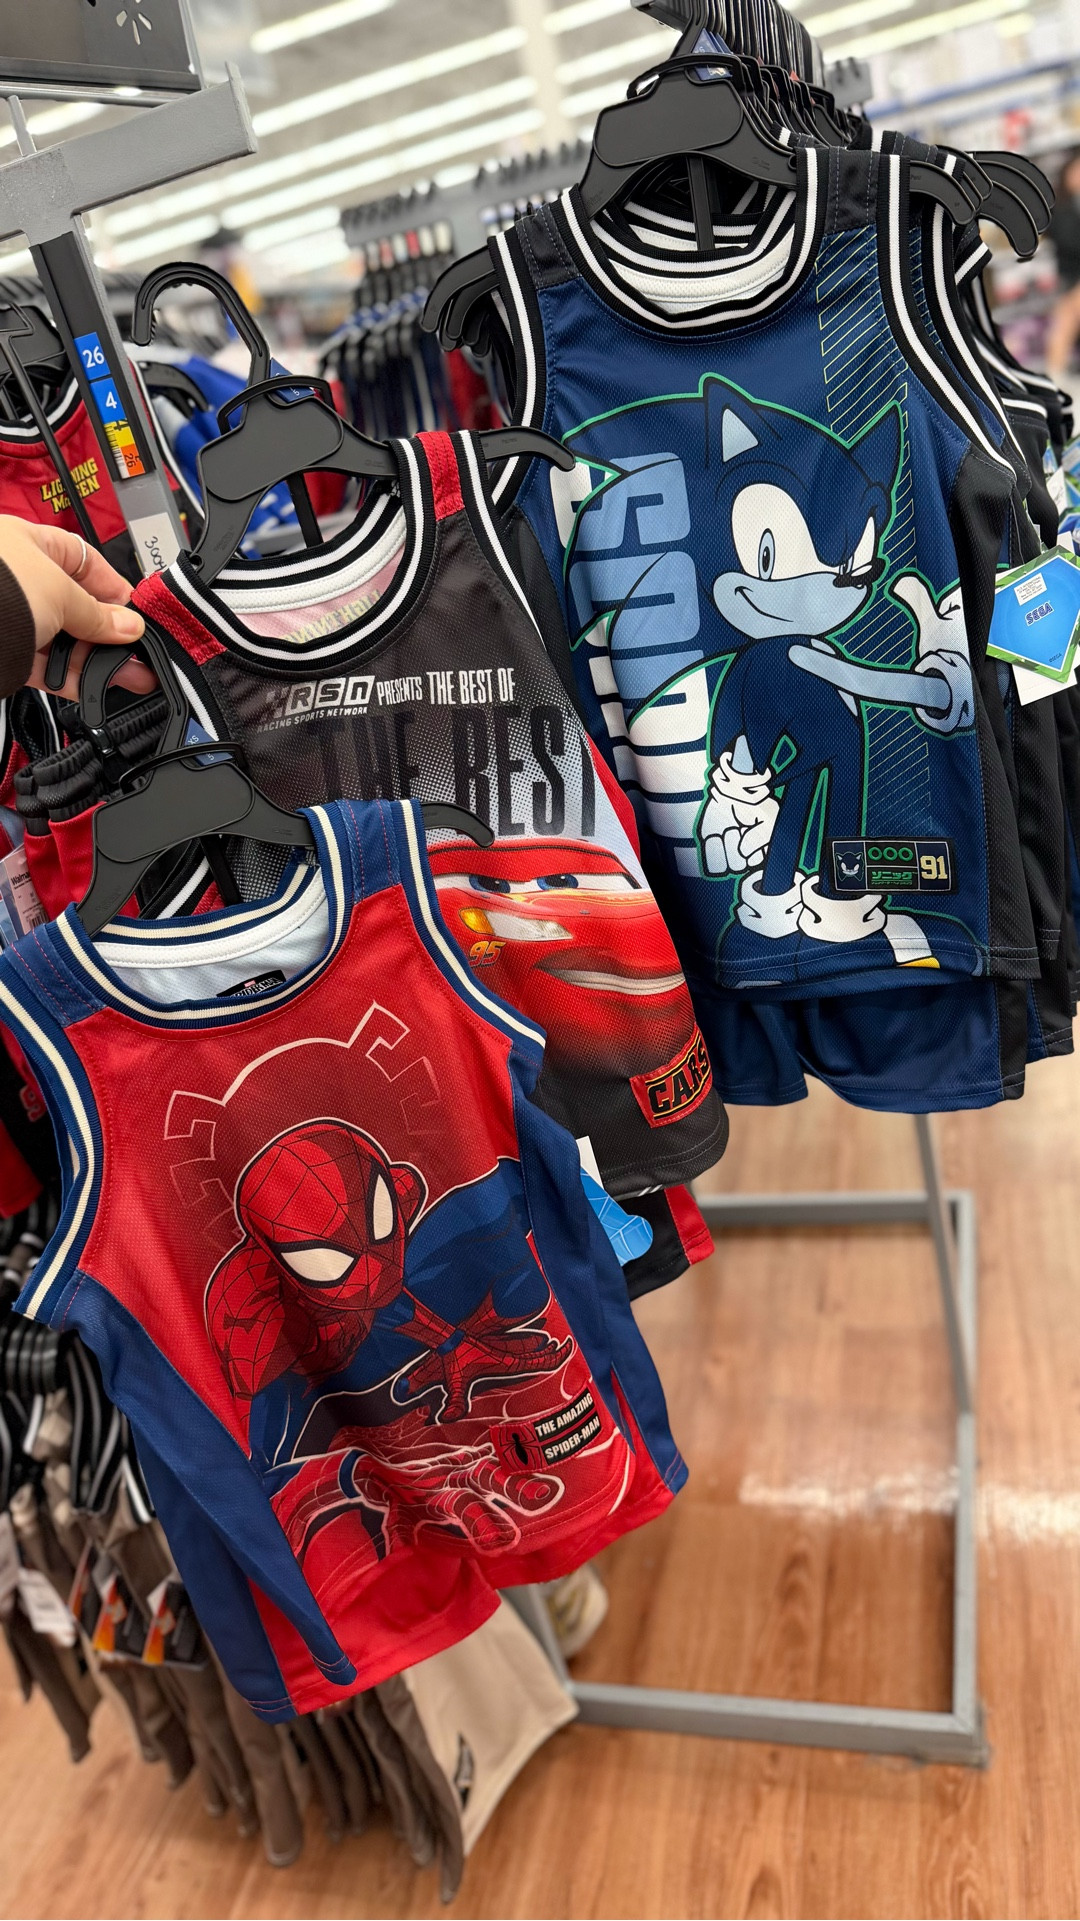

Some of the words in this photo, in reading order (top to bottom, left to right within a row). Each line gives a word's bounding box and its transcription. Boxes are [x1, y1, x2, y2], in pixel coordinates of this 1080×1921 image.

[82, 345, 105, 368] 26
[105, 391, 118, 409] 4
[124, 453, 137, 468] 26
[1025, 602, 1054, 626] SEGA
[376, 676, 423, 706] PRESENTS
[426, 671, 457, 705] THE
[458, 669, 493, 705] BEST
[497, 668, 516, 702] OF
[257, 717, 292, 733] RACING
[294, 709, 325, 724] SPORTS
[326, 706, 368, 717] NETWORK
[920, 855, 948, 880] 91
[469, 940, 507, 968] 95
[648, 1036, 709, 1114] CARS
[534, 1419, 557, 1437] THE
[556, 1392, 593, 1430] AMAZING
[544, 1415, 601, 1460] SPIDER-MAN
